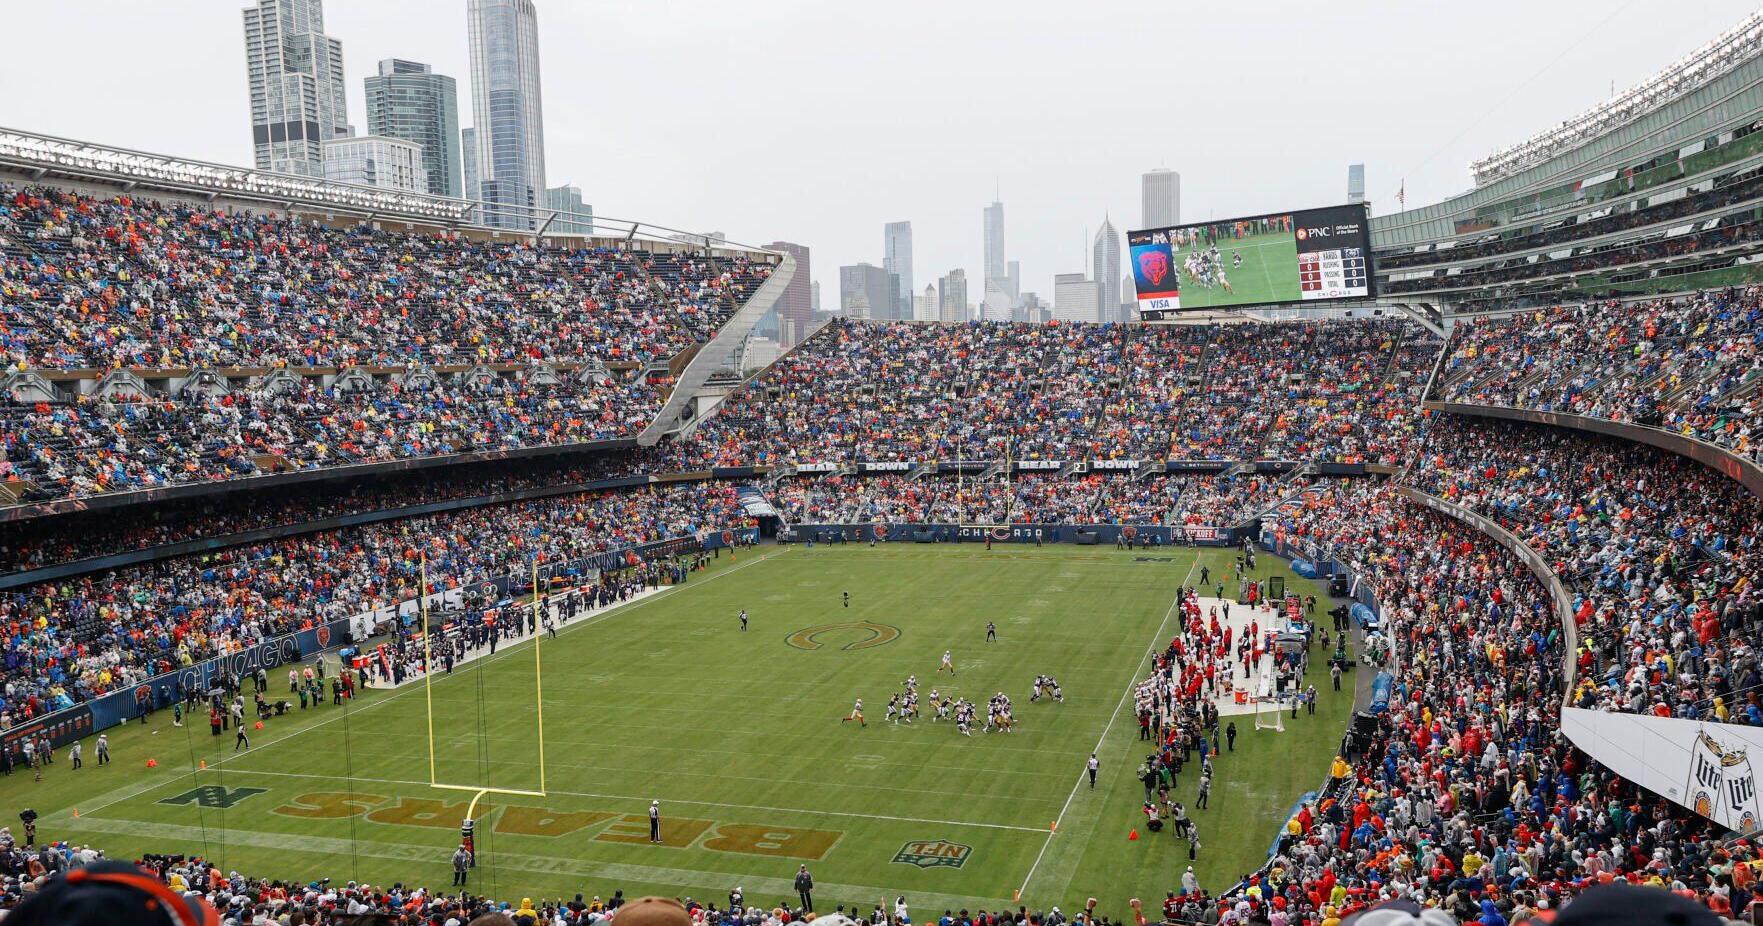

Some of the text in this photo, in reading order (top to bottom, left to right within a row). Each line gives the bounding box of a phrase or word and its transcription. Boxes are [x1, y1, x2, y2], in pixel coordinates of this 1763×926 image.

[1308, 227, 1330, 237] PNC
[1150, 300, 1170, 308] VISA
[866, 462, 909, 470] DOWN
[1019, 461, 1060, 469] BEAR
[1094, 460, 1140, 469] DOWN
[178, 633, 299, 695] CHICAGO
[1696, 751, 1721, 790] Lite
[1728, 775, 1754, 811] Lite
[267, 791, 846, 861] BEARS
[911, 843, 965, 857] NFL
